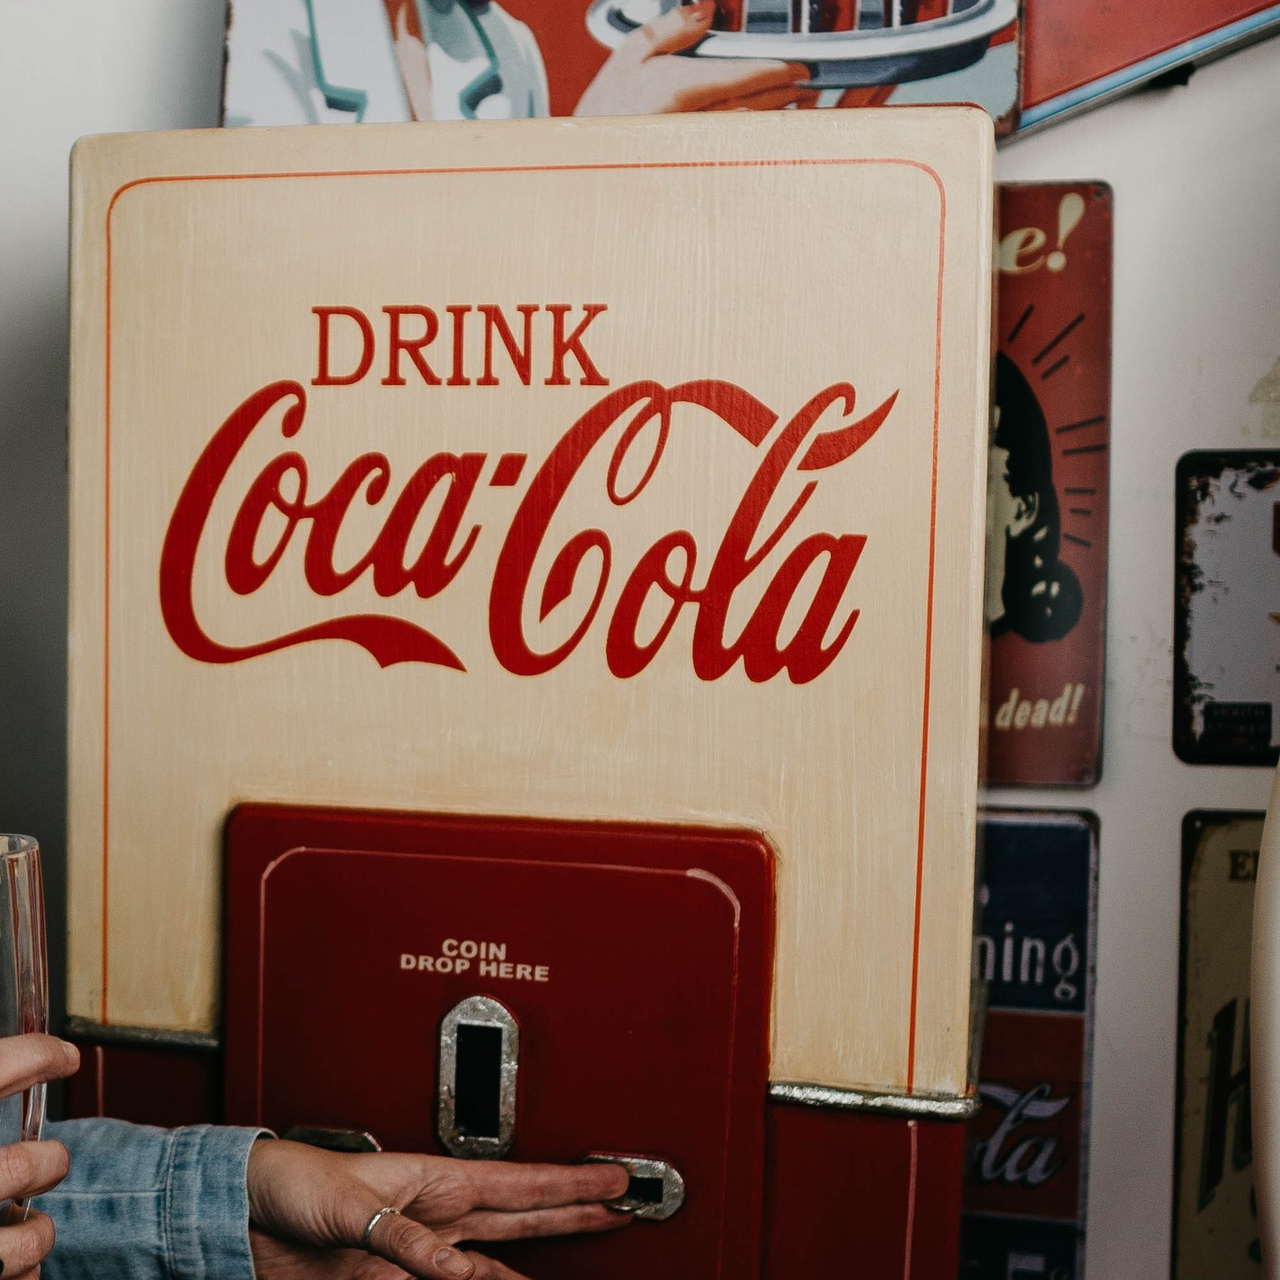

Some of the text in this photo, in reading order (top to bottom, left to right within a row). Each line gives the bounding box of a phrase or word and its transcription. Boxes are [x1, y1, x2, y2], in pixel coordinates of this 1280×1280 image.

[311, 303, 610, 387] DRINK
[159, 380, 900, 685] Coca-Cola
[994, 681, 1086, 732] dead!
[399, 952, 551, 983] DROP HERE
[441, 937, 508, 961] COIN
